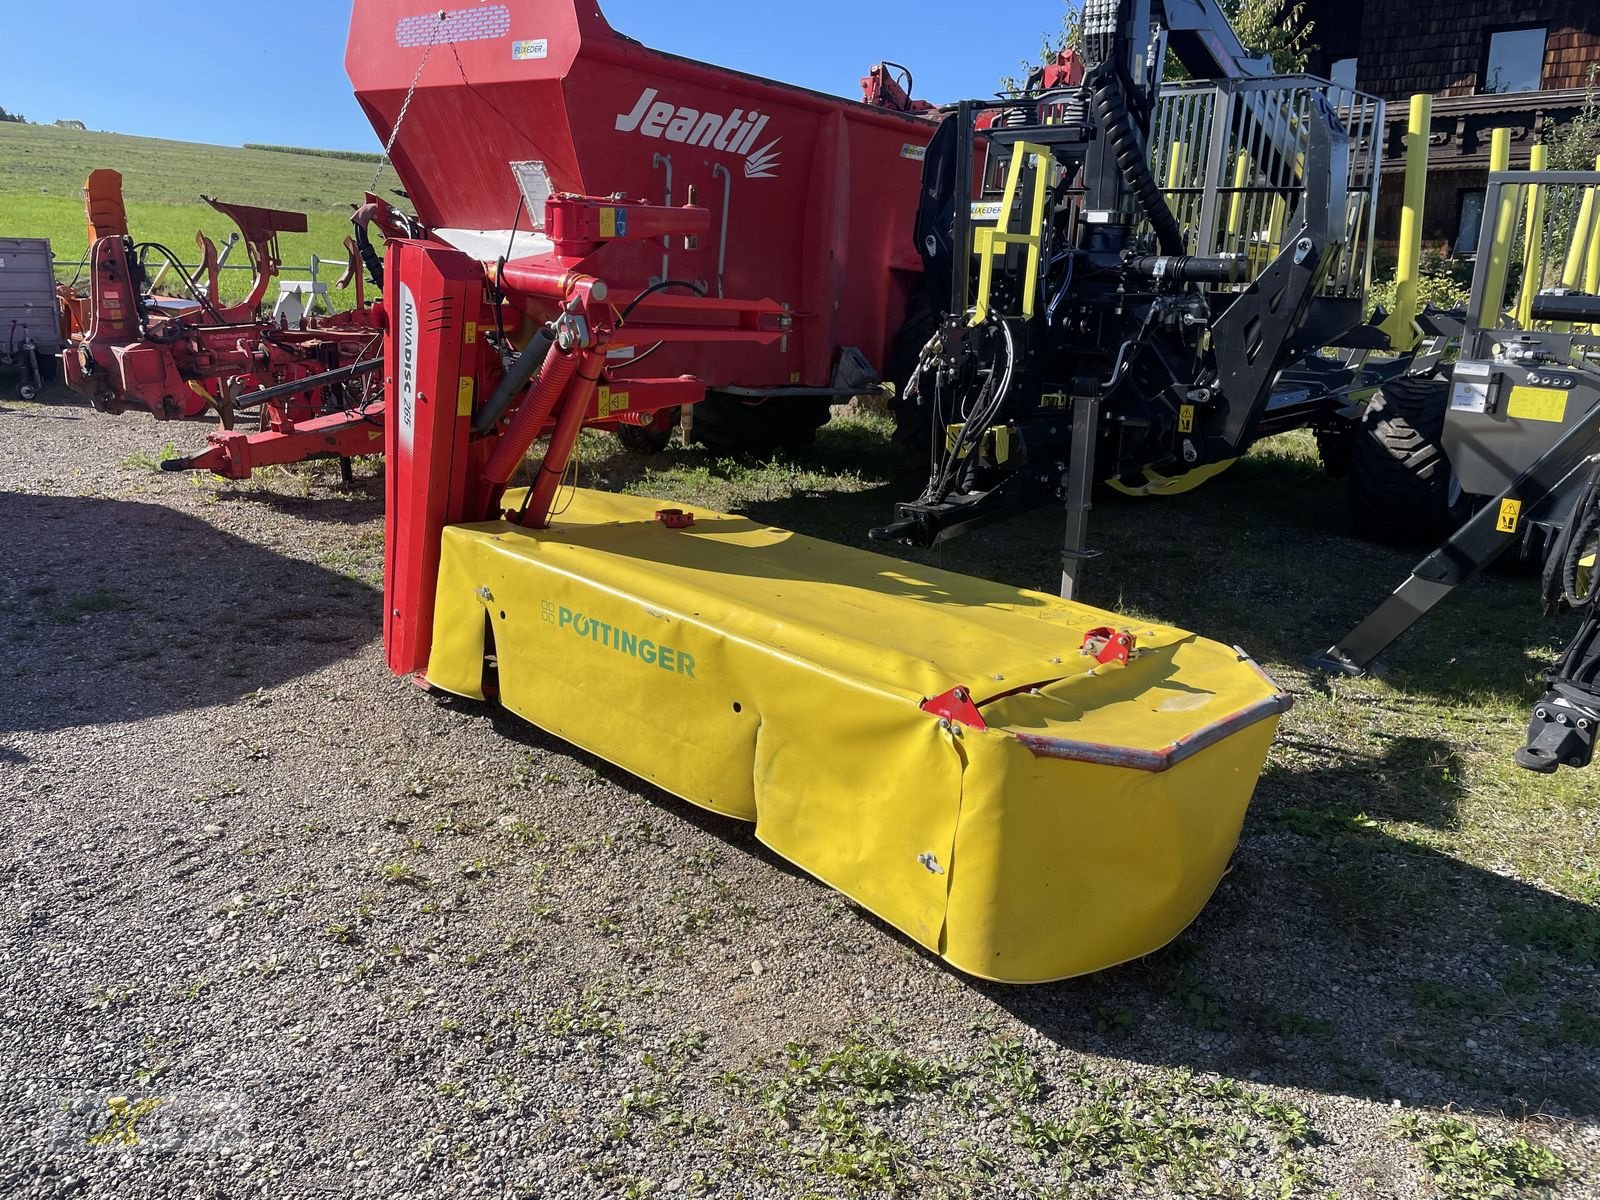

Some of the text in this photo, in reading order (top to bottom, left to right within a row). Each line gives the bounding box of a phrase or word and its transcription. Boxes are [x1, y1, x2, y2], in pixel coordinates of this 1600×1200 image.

[614, 87, 770, 155] Jeantil
[403, 303, 412, 429] NOVADISC 265
[558, 606, 696, 679] PÖTTINGER
